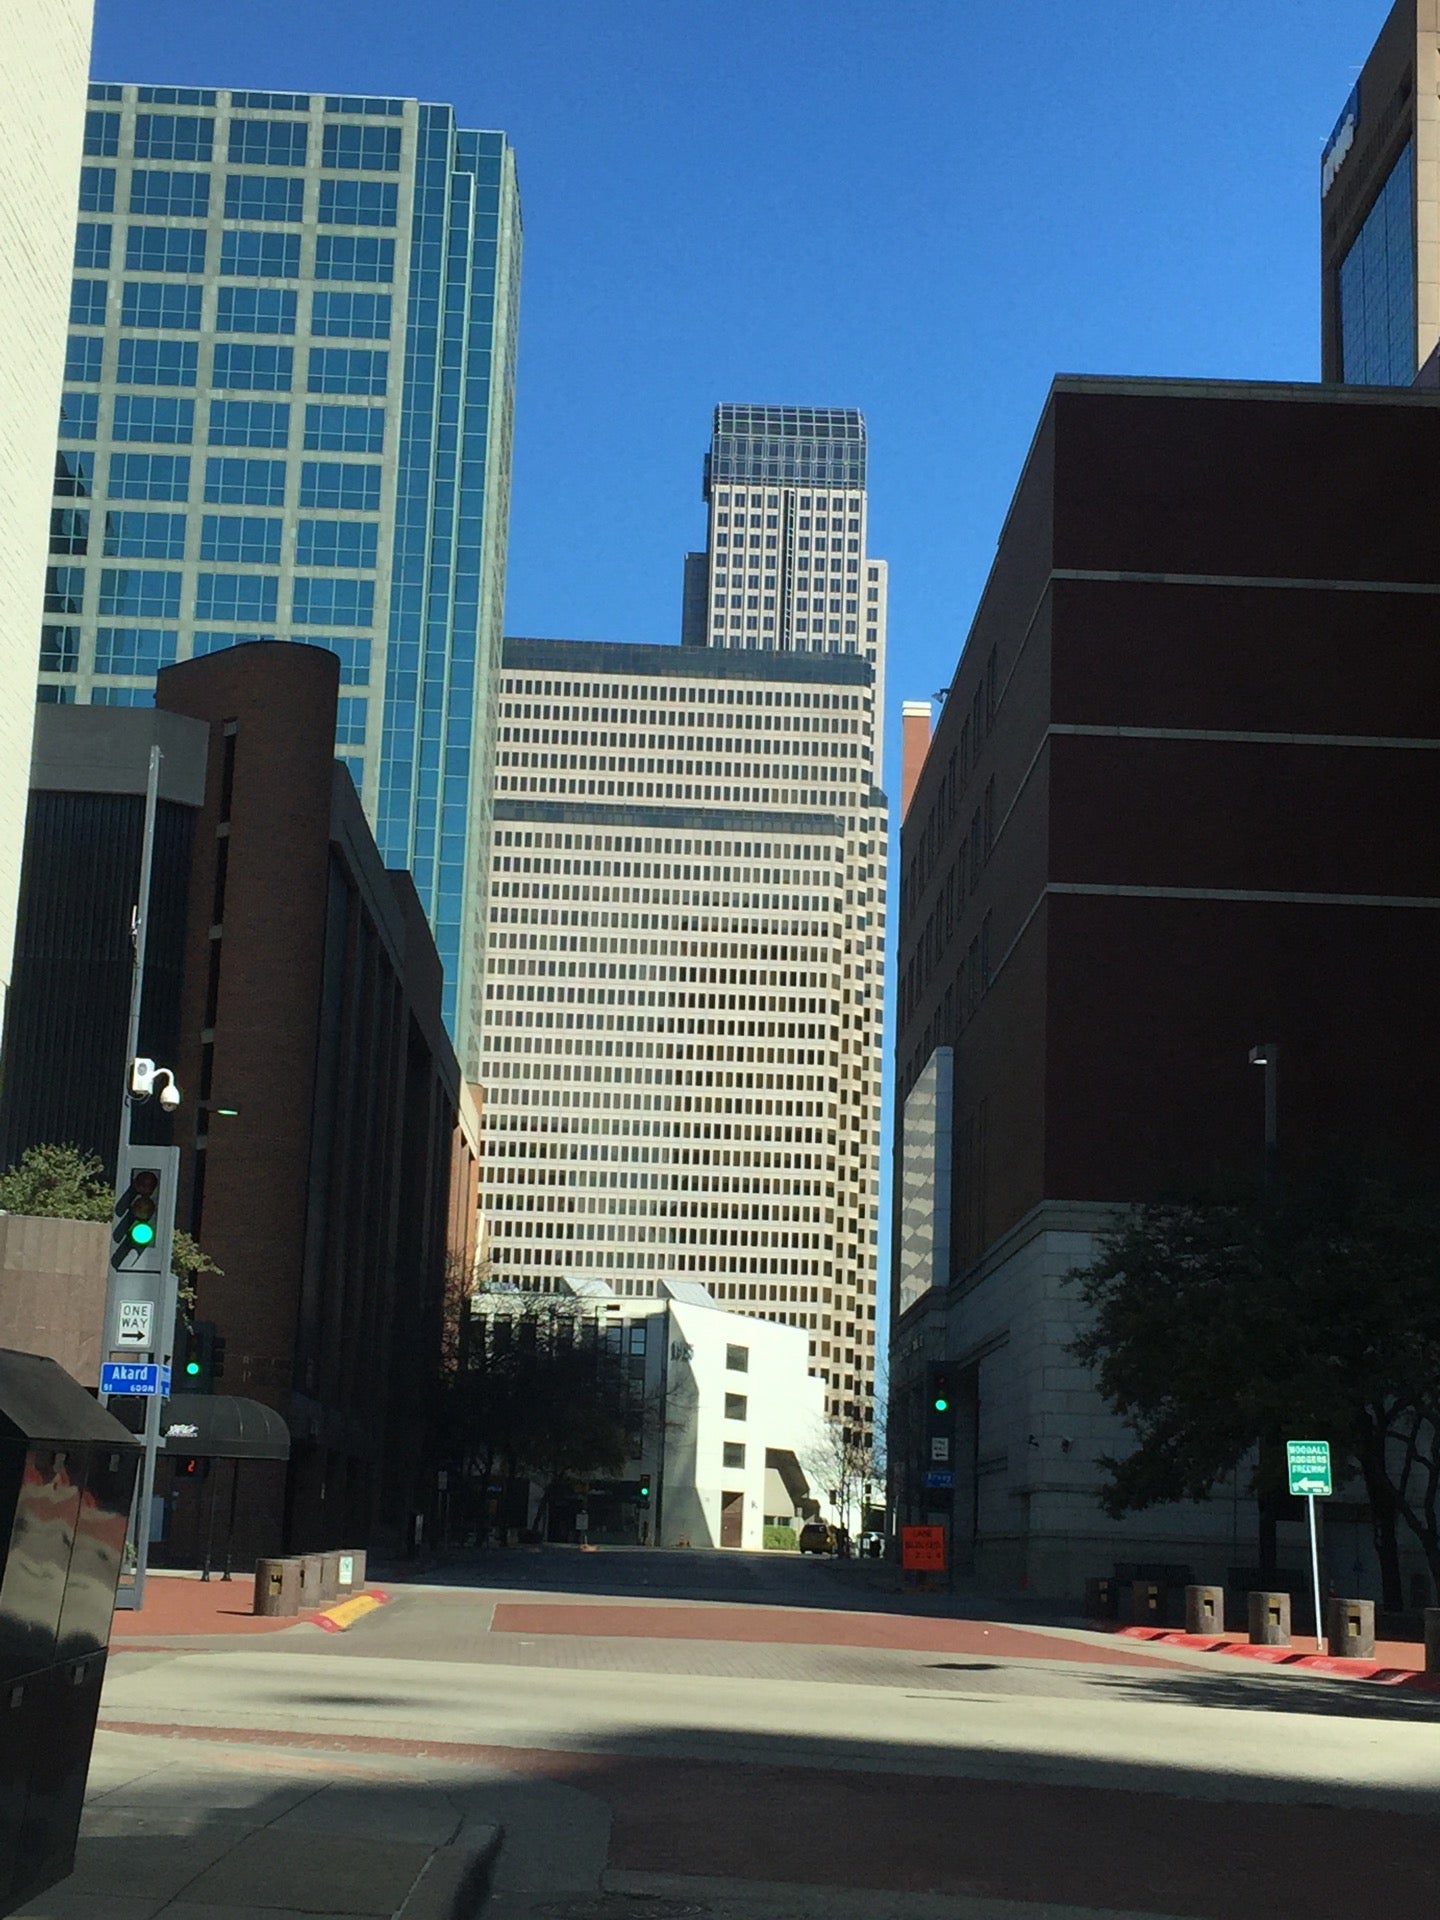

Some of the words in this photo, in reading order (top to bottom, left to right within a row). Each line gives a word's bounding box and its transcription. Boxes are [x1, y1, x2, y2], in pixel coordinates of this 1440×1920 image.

[123, 1305, 148, 1317] ONE
[121, 1318, 148, 1329] WAY
[112, 1366, 148, 1380] Akard
